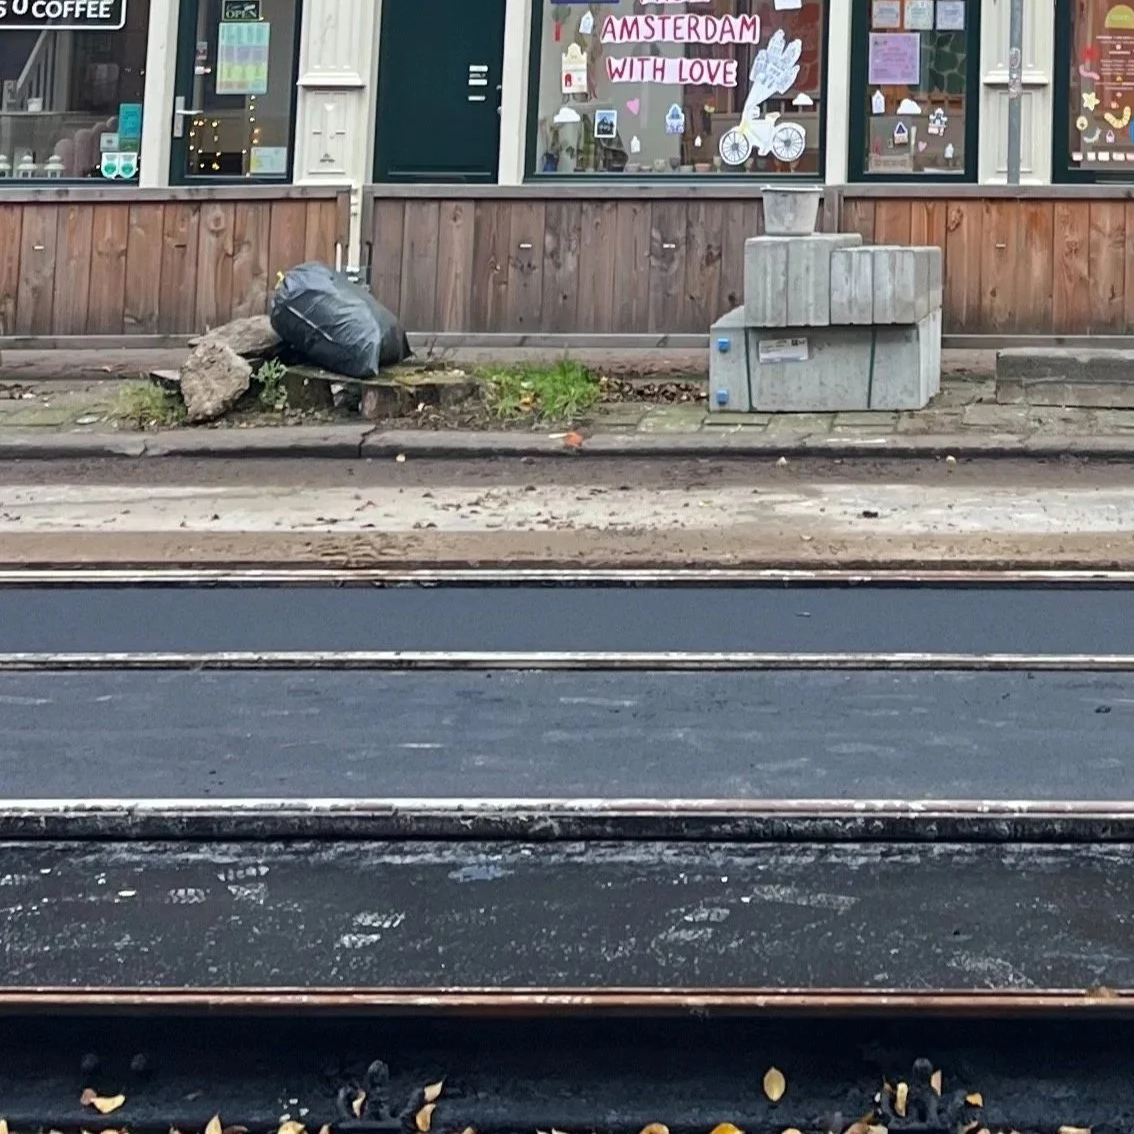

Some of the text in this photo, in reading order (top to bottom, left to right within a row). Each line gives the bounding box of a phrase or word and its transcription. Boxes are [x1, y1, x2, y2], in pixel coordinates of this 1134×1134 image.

[31, 0, 112, 19] COFFEE
[602, 15, 757, 42] AMSTERDAM
[607, 58, 735, 85] WITH LOVE
